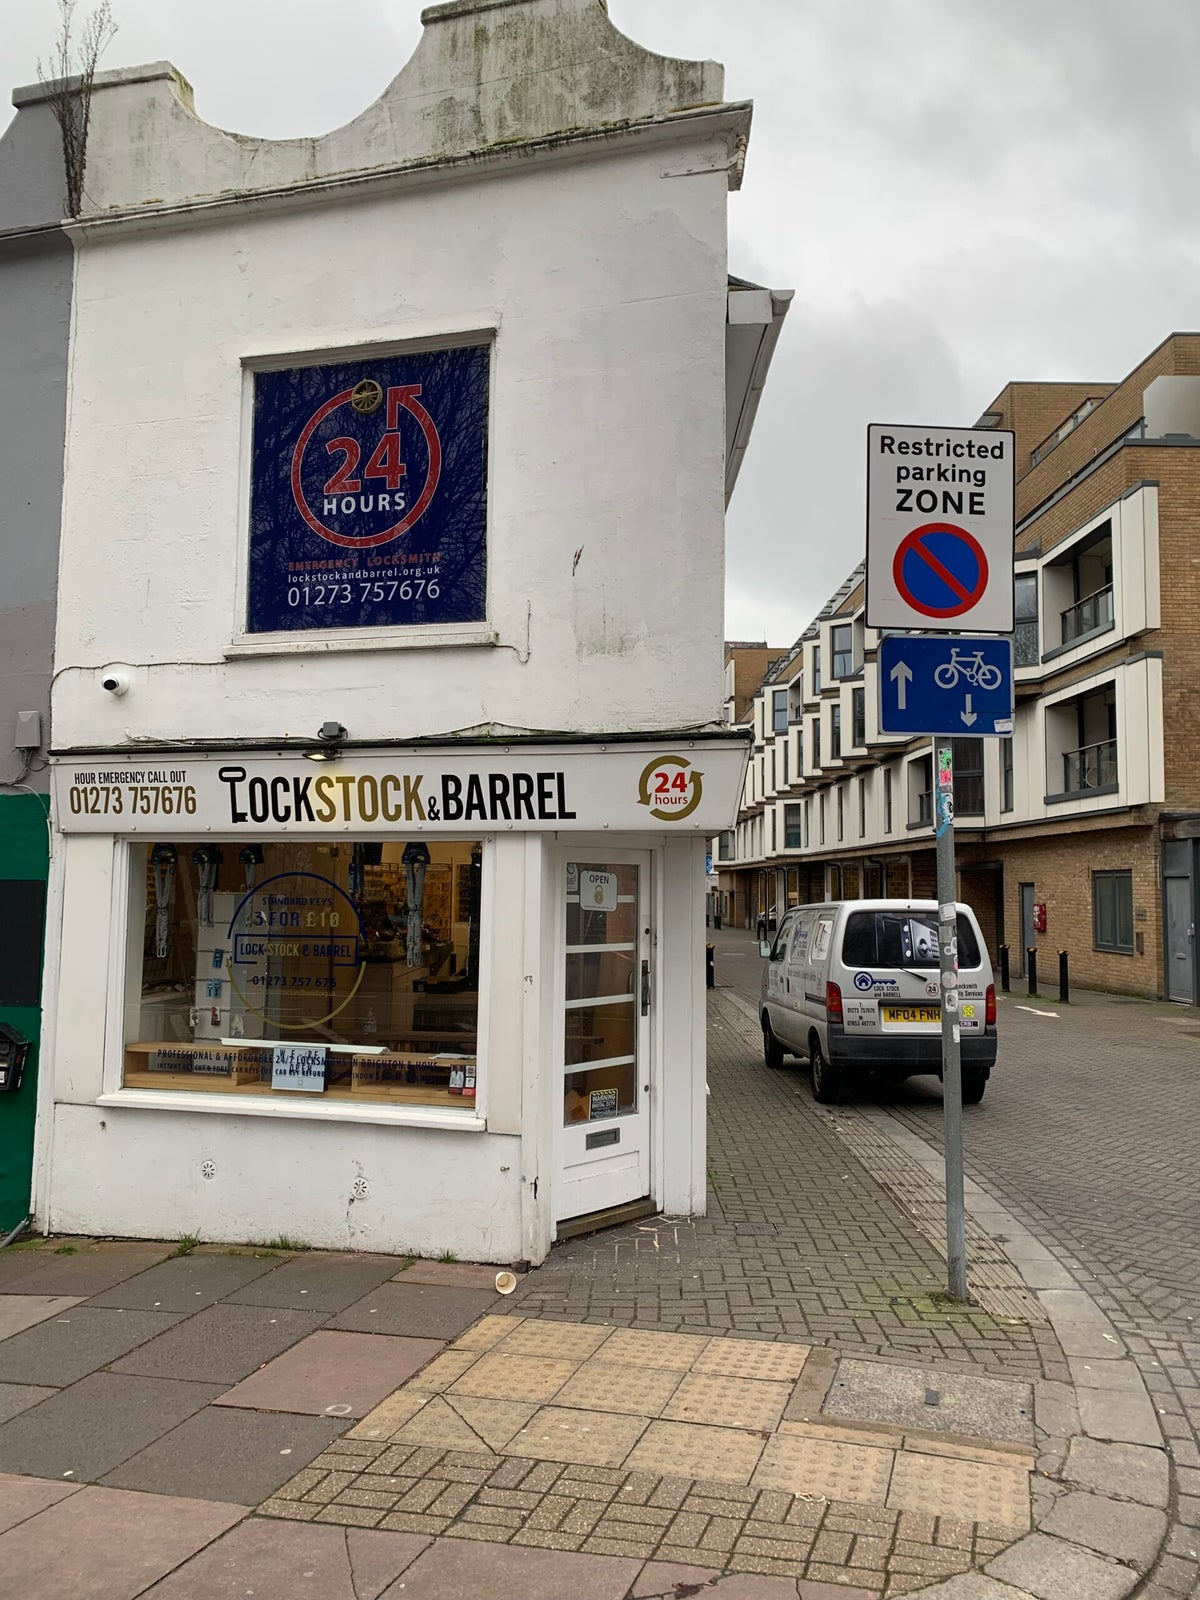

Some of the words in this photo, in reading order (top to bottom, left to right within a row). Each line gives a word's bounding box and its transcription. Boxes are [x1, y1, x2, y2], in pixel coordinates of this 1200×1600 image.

[880, 435, 1004, 460] Restricted
[324, 432, 406, 495] 24
[896, 463, 986, 487] parking
[323, 492, 406, 515] HOURS
[896, 489, 986, 516] ZONE
[288, 556, 358, 571] EMERGENCY
[367, 552, 441, 567] LOCKSMITH
[288, 565, 440, 583] lockstockandbarrel.org.uk
[287, 584, 351, 606] 01273
[360, 579, 440, 603] 757676
[74, 772, 97, 785] HOUR
[98, 771, 146, 784] EMERGENCY
[147, 771, 168, 783] CALL
[169, 770, 187, 783] OUT
[654, 772, 688, 793] 24
[69, 786, 124, 815] 01273
[128, 786, 197, 815] 757676
[655, 793, 688, 805] hours
[589, 874, 609, 884] OPEN
[262, 896, 307, 906] STANDARD
[309, 897, 333, 906] KEYS
[254, 911, 264, 926] 3
[269, 911, 300, 926] FOR
[305, 912, 340, 928] £10
[240, 943, 265, 956] LOCK
[267, 943, 300, 957] STOCK
[313, 945, 351, 957] BARREL
[252, 976, 287, 986] 01273
[291, 977, 311, 987] 757
[315, 977, 337, 988] 676
[888, 1009, 916, 1020] MF04
[920, 1009, 941, 1020] FNH
[157, 1049, 213, 1060] PROFESSIONAL
[224, 1052, 273, 1064] AFFORDABLE
[296, 1056, 345, 1067] LOCKSMTHS
[361, 1058, 404, 1070] BRIGHTON
[415, 1061, 438, 1072] HOVE
